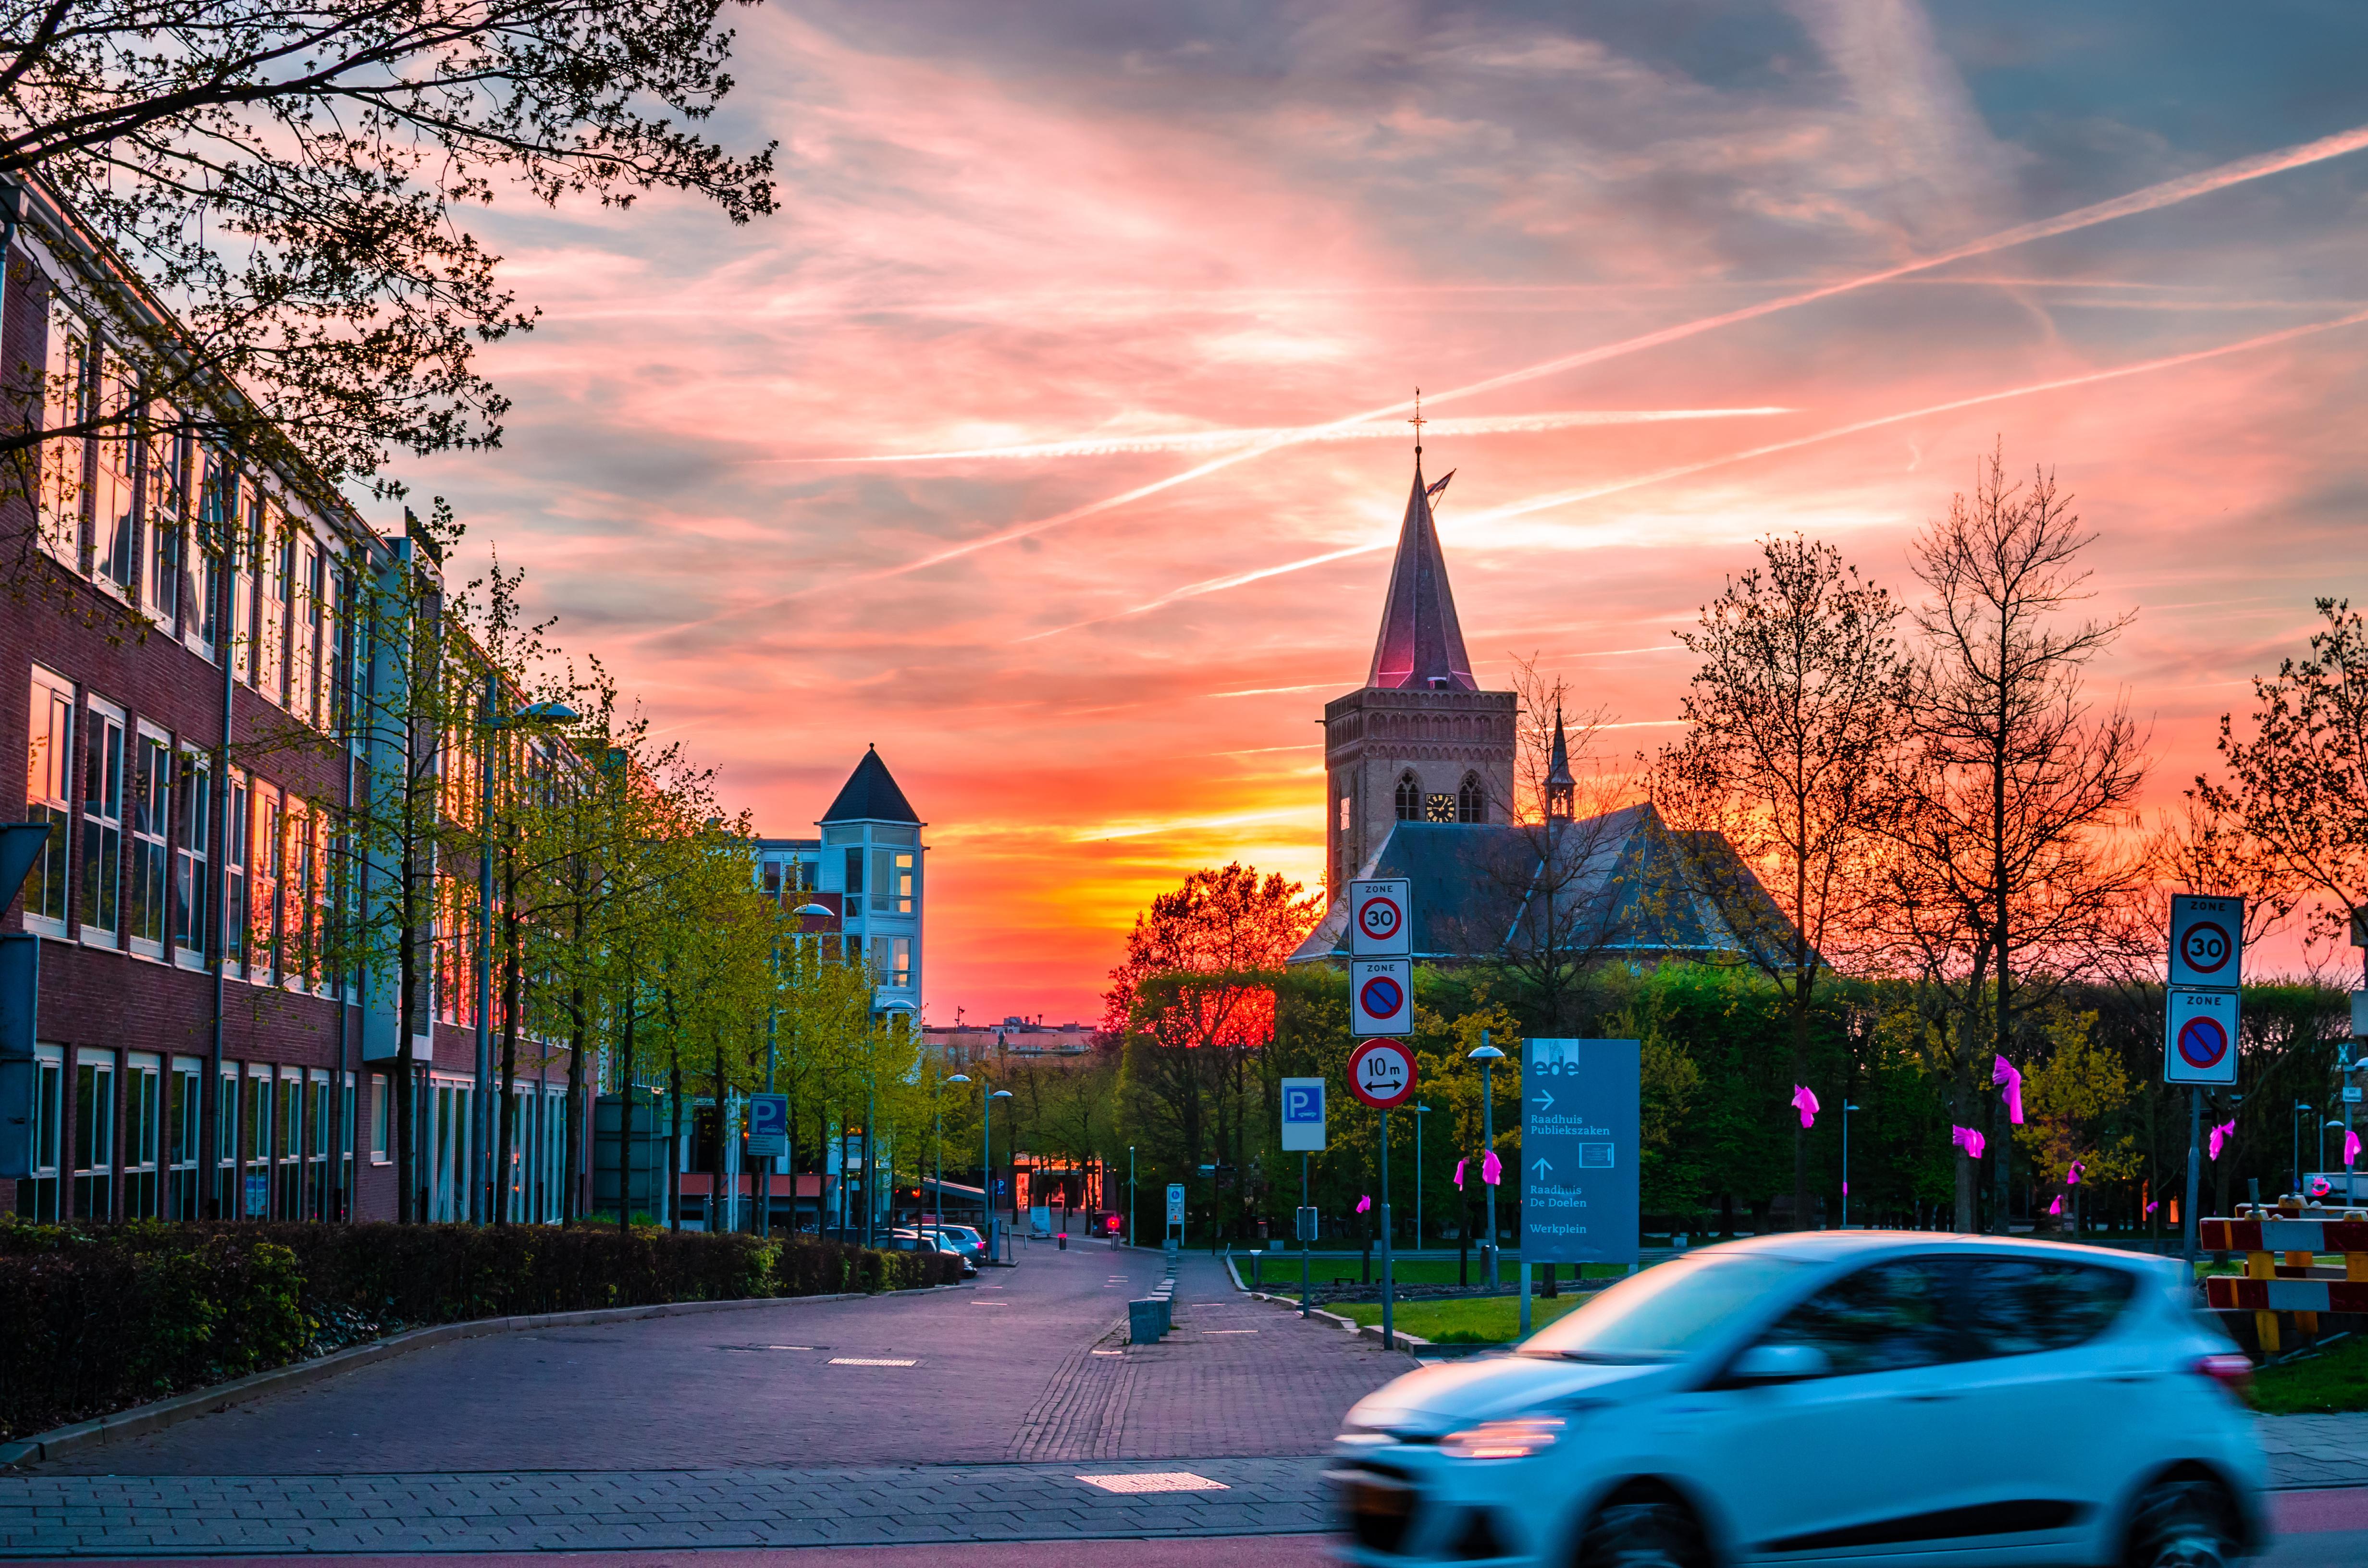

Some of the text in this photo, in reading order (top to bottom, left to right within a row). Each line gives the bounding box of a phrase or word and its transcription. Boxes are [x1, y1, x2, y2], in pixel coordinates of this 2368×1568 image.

[2190, 901, 2226, 912] ZONE
[1367, 910, 1394, 927] 30
[2190, 937, 2223, 958] 30
[1367, 964, 1395, 972] ZONE
[2187, 996, 2221, 1006] ZONE
[1368, 1057, 1400, 1077] 10 m
[1532, 1055, 1579, 1077] ede
[1289, 1091, 1308, 1118] P
[752, 1101, 777, 1133] P
[1531, 1114, 1582, 1124] Raadhuis
[1531, 1125, 1610, 1135] Publiekszaken
[999, 1180, 1004, 1189] P
[1530, 1185, 1582, 1194] Raadhuis
[1530, 1198, 1587, 1207] De Doelen
[1529, 1224, 1587, 1236] Werkplein
